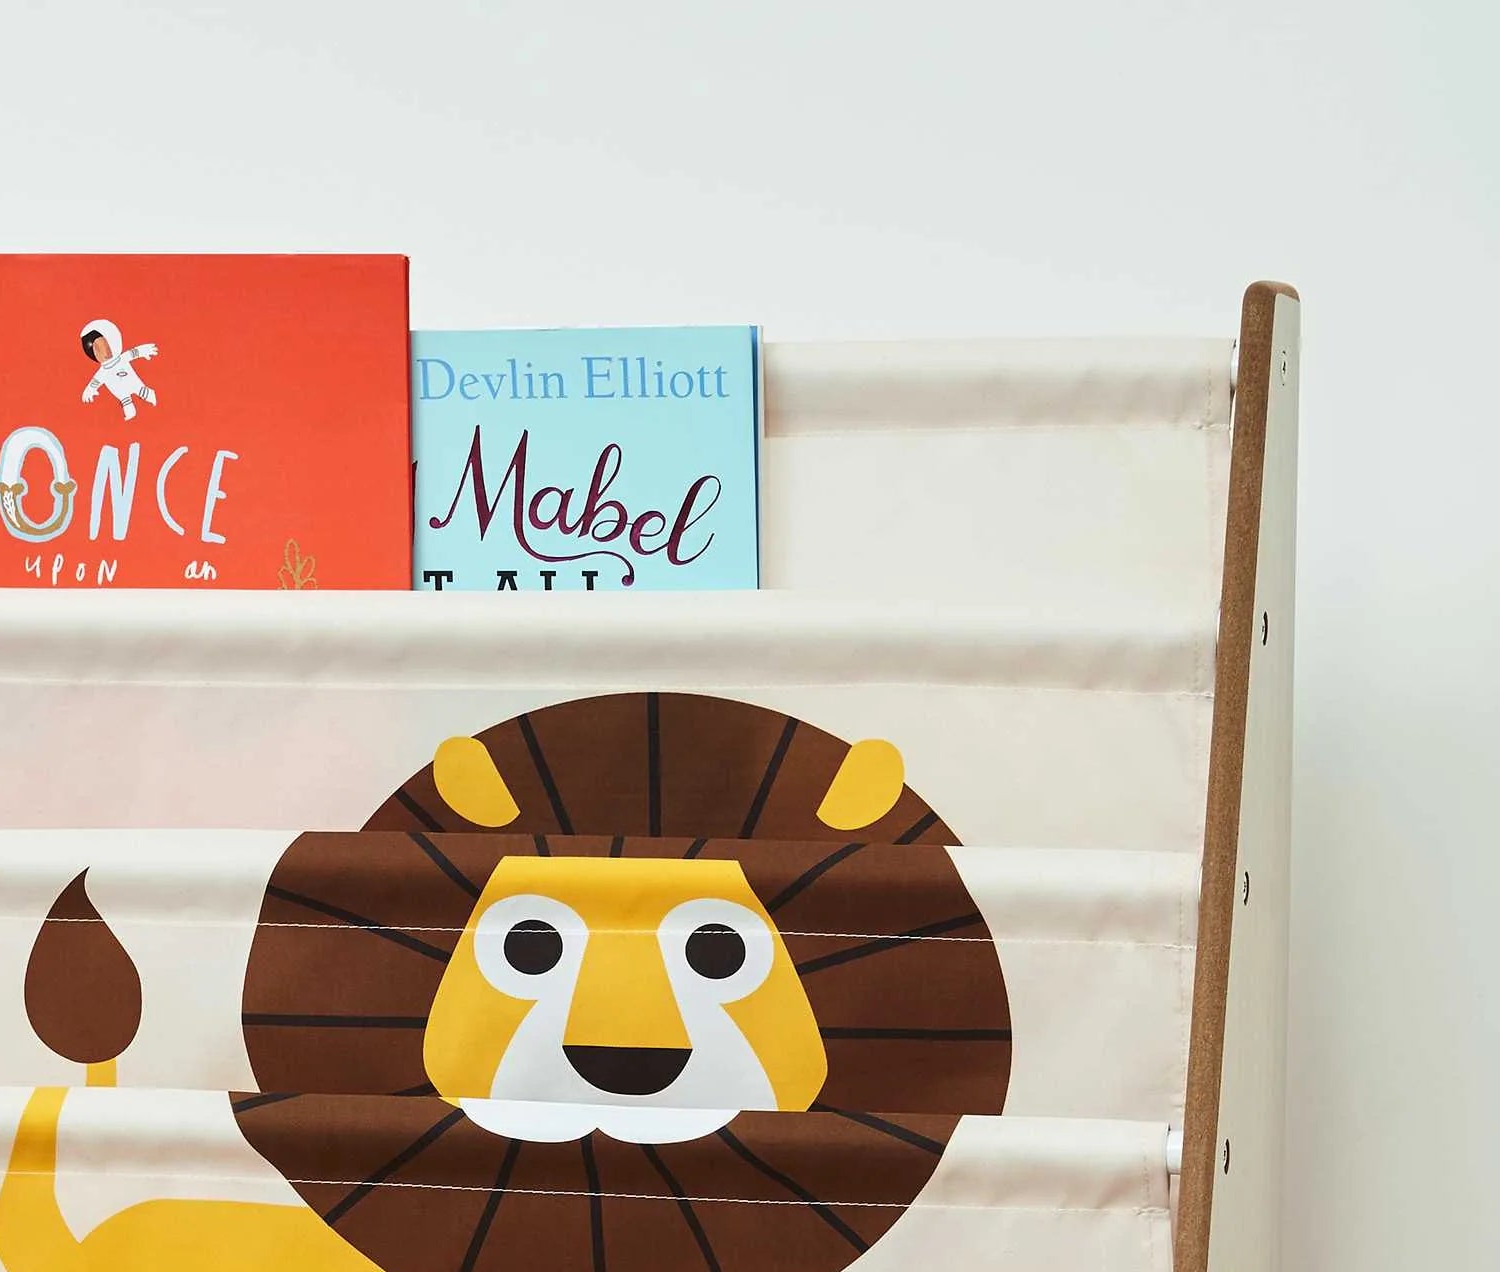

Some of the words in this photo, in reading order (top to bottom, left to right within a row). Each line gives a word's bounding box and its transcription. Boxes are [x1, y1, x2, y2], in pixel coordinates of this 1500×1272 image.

[417, 357, 568, 401] Devlin
[581, 355, 731, 400] Elliott
[429, 424, 722, 587] Mabel
[184, 560, 218, 581] an
